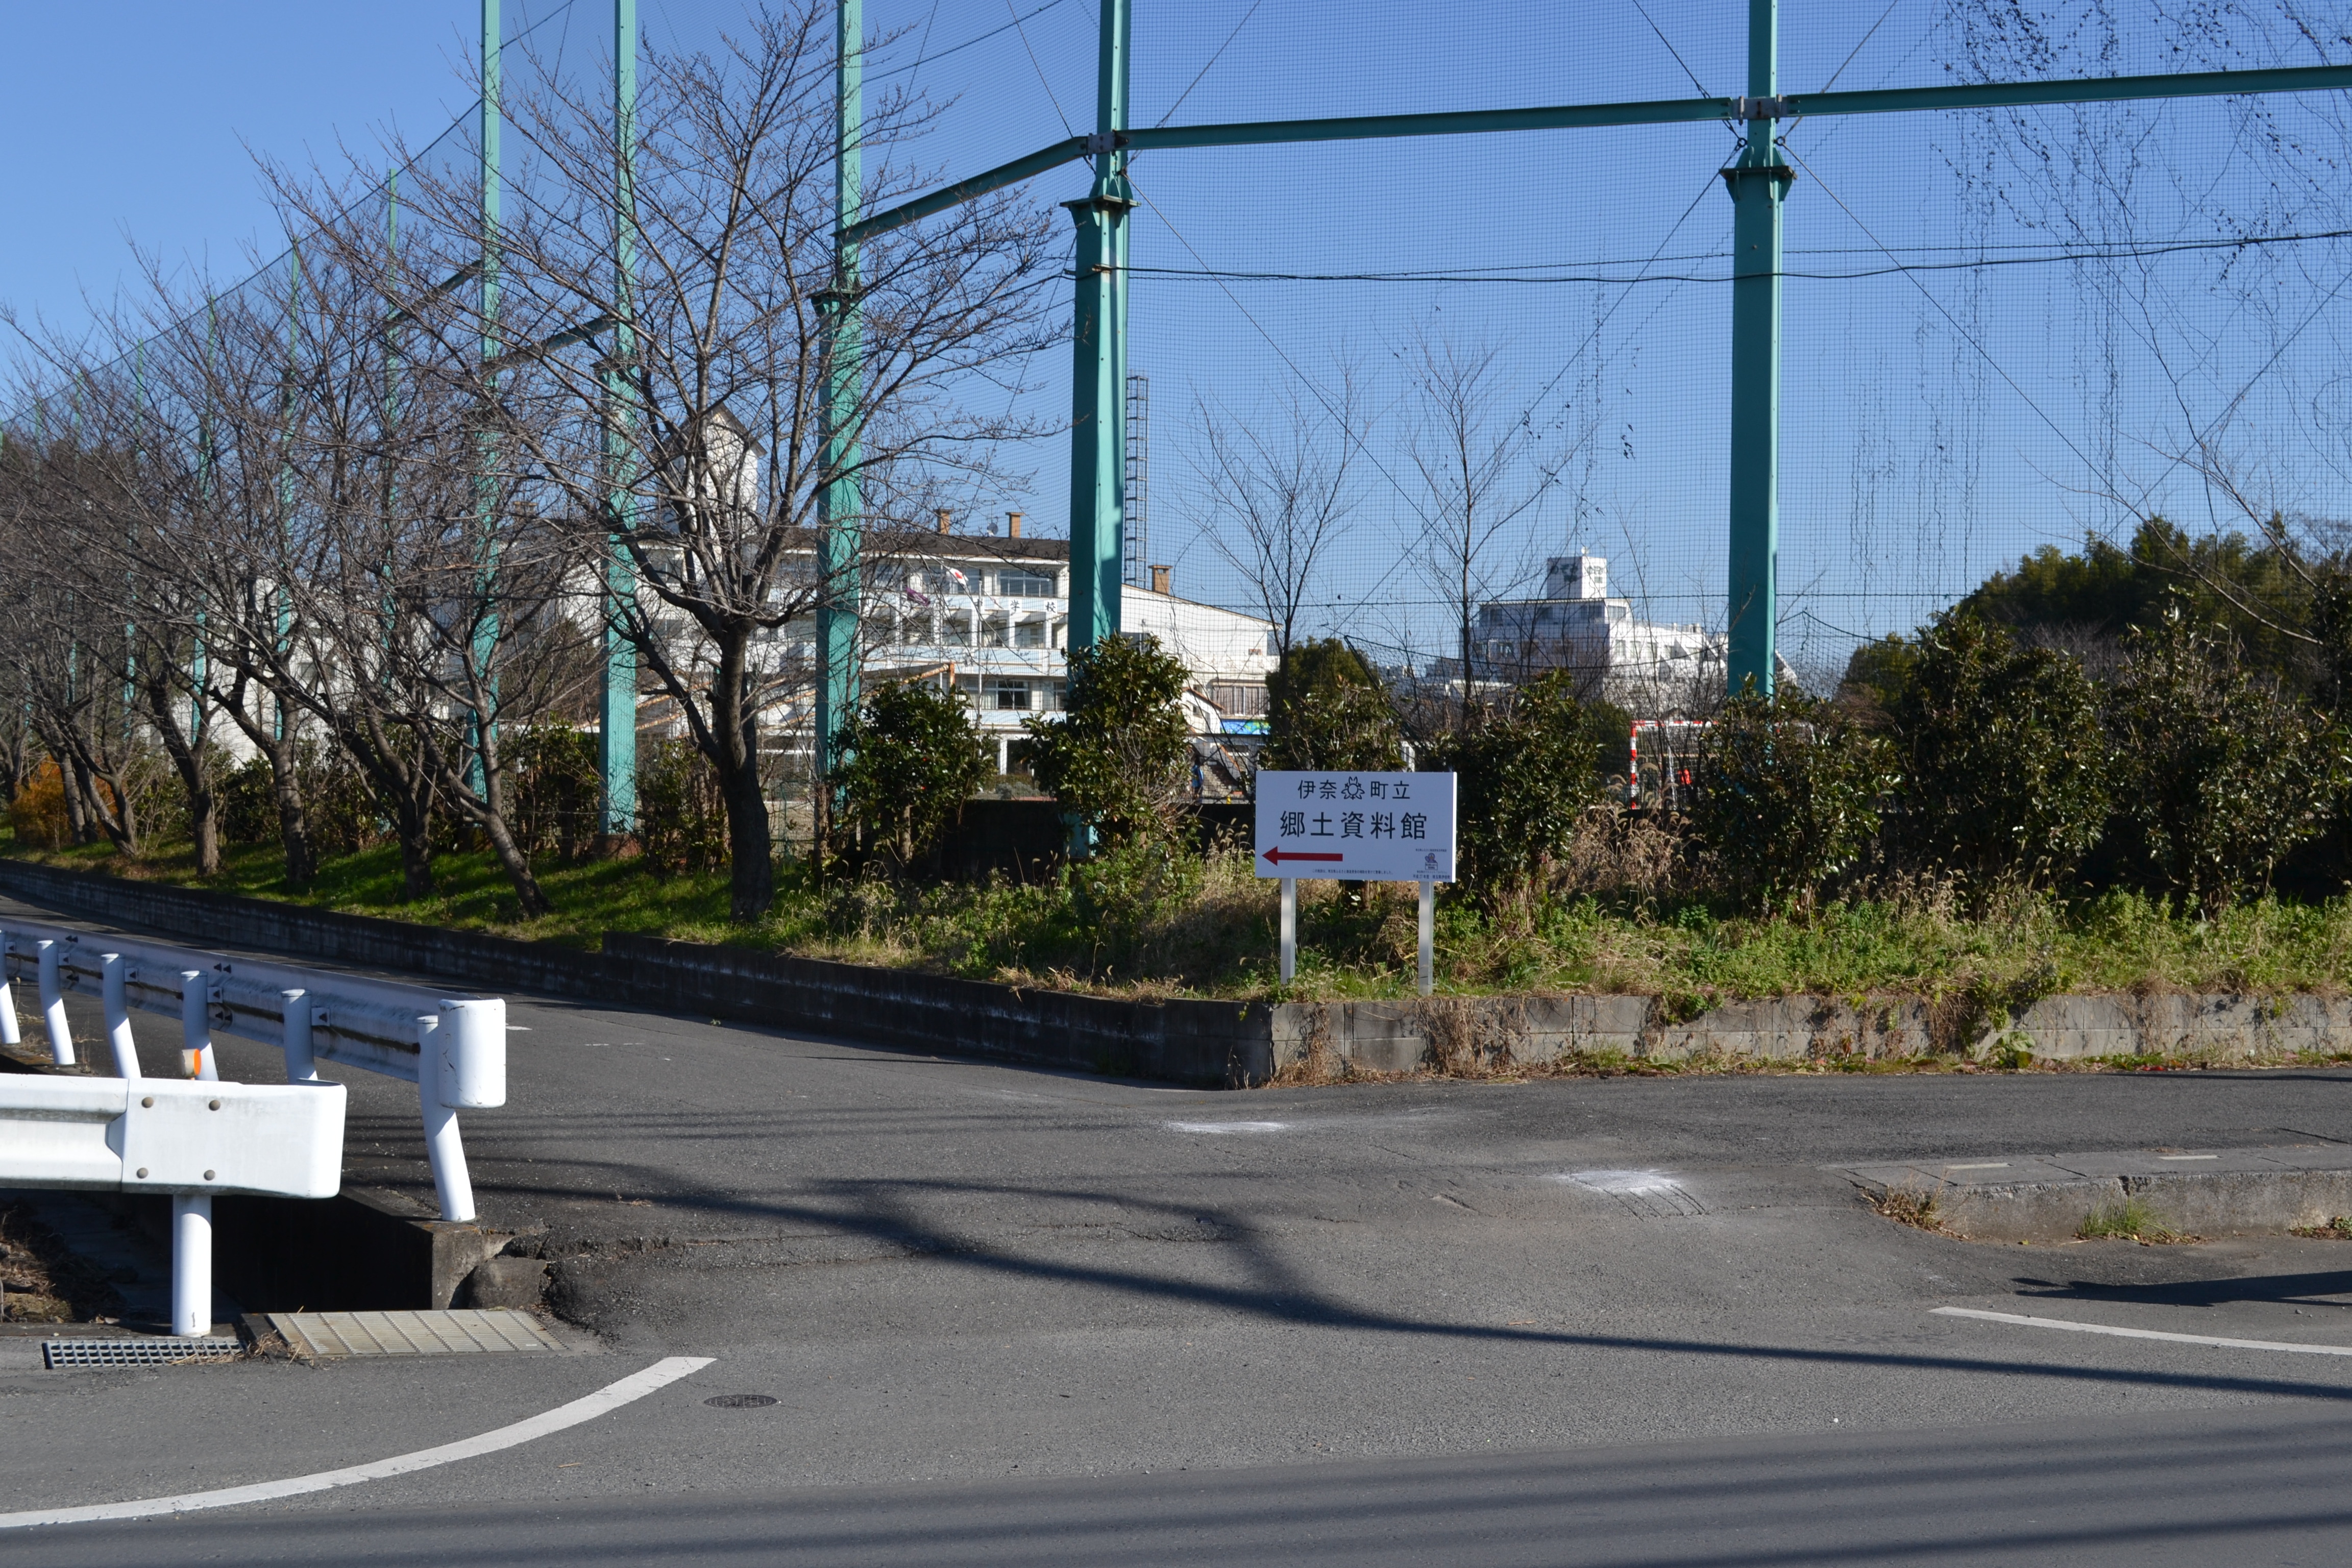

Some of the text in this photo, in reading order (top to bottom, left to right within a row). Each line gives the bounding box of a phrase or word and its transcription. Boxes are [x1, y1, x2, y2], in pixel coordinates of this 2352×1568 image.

[1280, 811, 1427, 840] 郷土資料館
